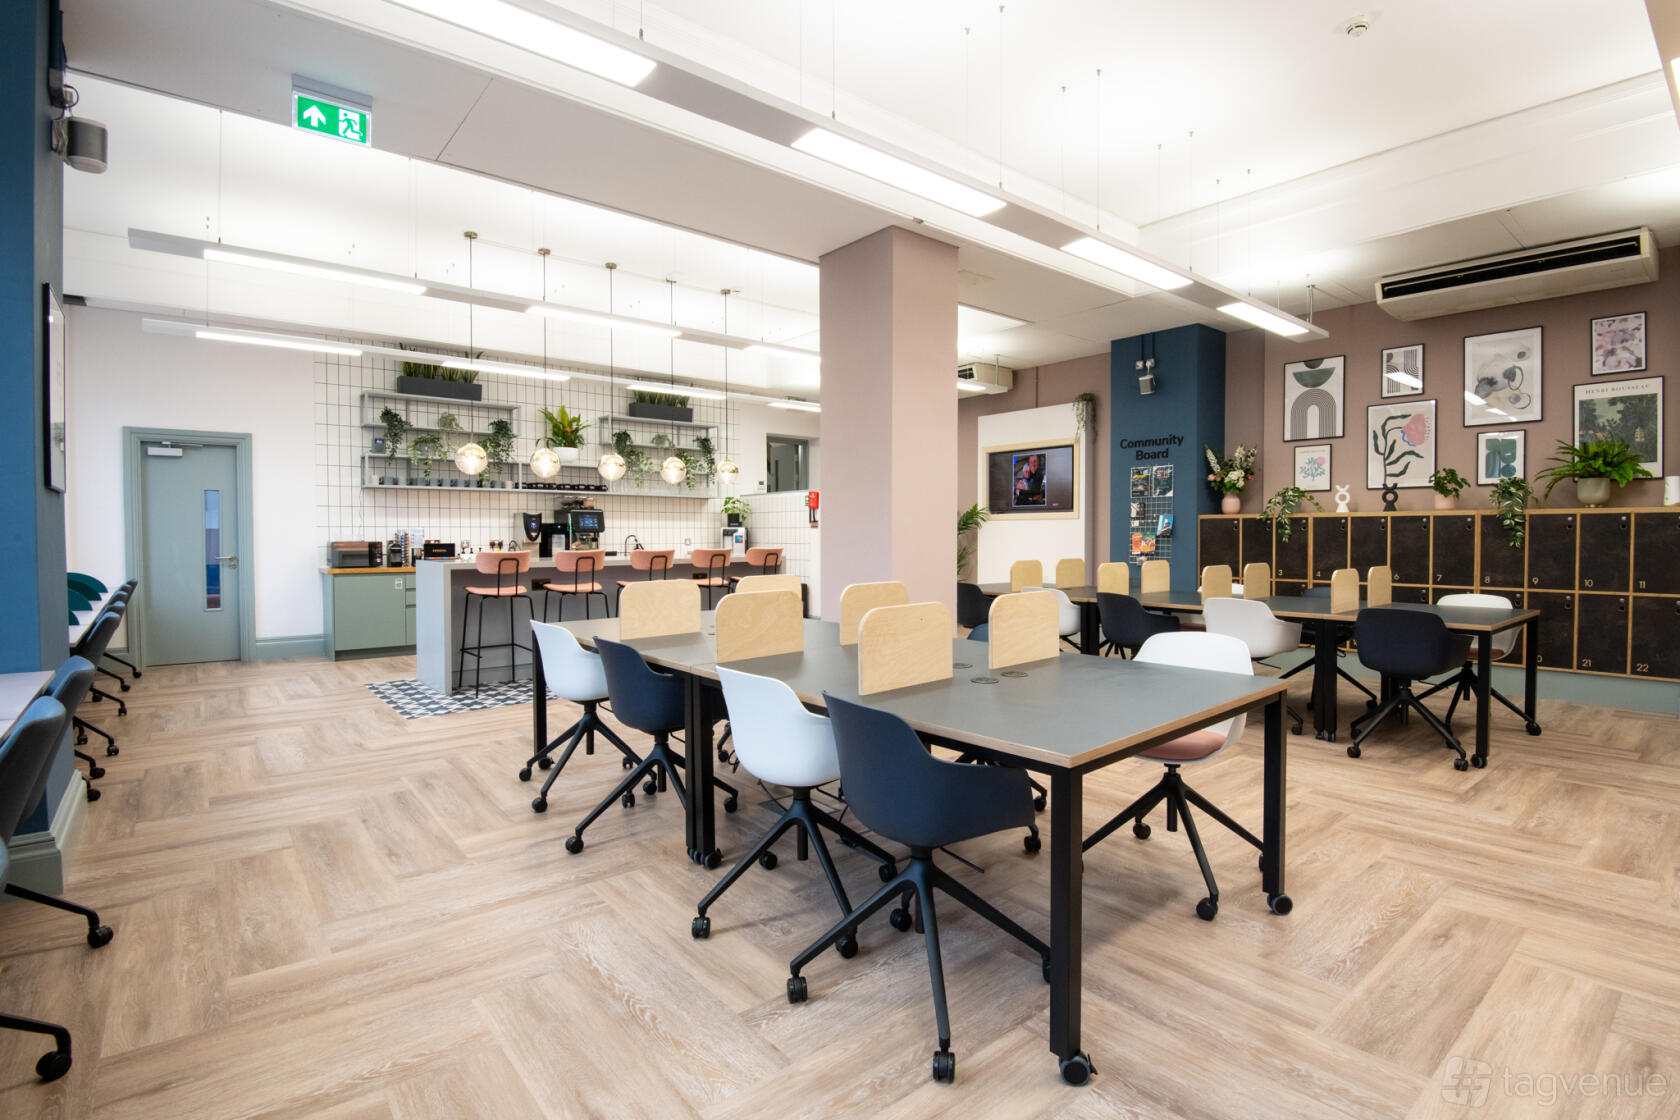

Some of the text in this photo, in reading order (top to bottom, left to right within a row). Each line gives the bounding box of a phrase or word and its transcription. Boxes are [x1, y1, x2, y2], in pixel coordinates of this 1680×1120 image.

[1120, 434, 1184, 449] Community
[1136, 448, 1169, 461] Board
[1394, 573, 1400, 581] 6
[1436, 574, 1442, 582] 7
[1484, 576, 1491, 584] 8
[1532, 577, 1539, 585] 9
[1584, 579, 1594, 588] 10
[1639, 581, 1646, 589] 11
[1582, 659, 1592, 668] 21
[1636, 663, 1649, 673] 22
